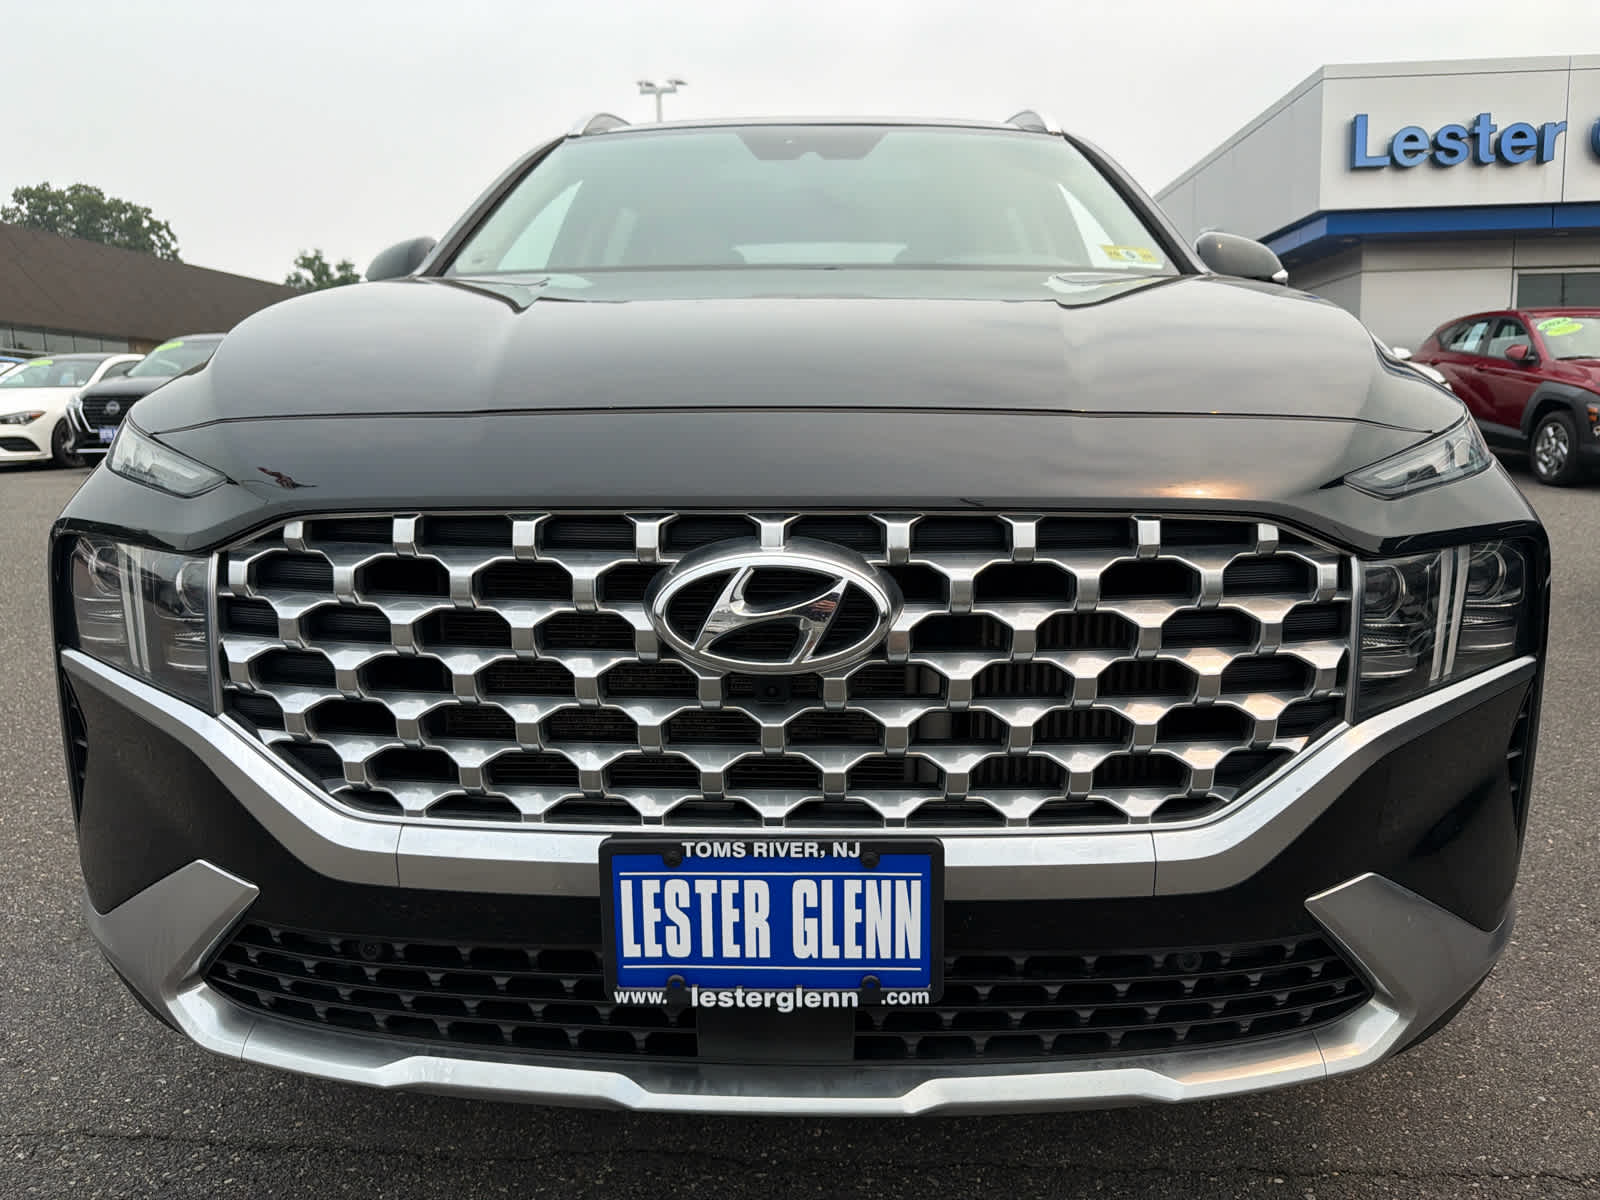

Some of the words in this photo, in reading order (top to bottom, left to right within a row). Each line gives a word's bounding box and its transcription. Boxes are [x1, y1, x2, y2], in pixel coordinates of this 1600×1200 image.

[1352, 112, 1567, 168] Lester
[682, 842, 746, 858] TOMS
[754, 842, 826, 859] RIVER,
[833, 842, 861, 858] NJ
[620, 879, 772, 958] LESTER
[791, 879, 922, 959] GLENN
[615, 990, 668, 1004] www.
[692, 986, 859, 1012] lesterglenn
[881, 989, 930, 1005] .com
